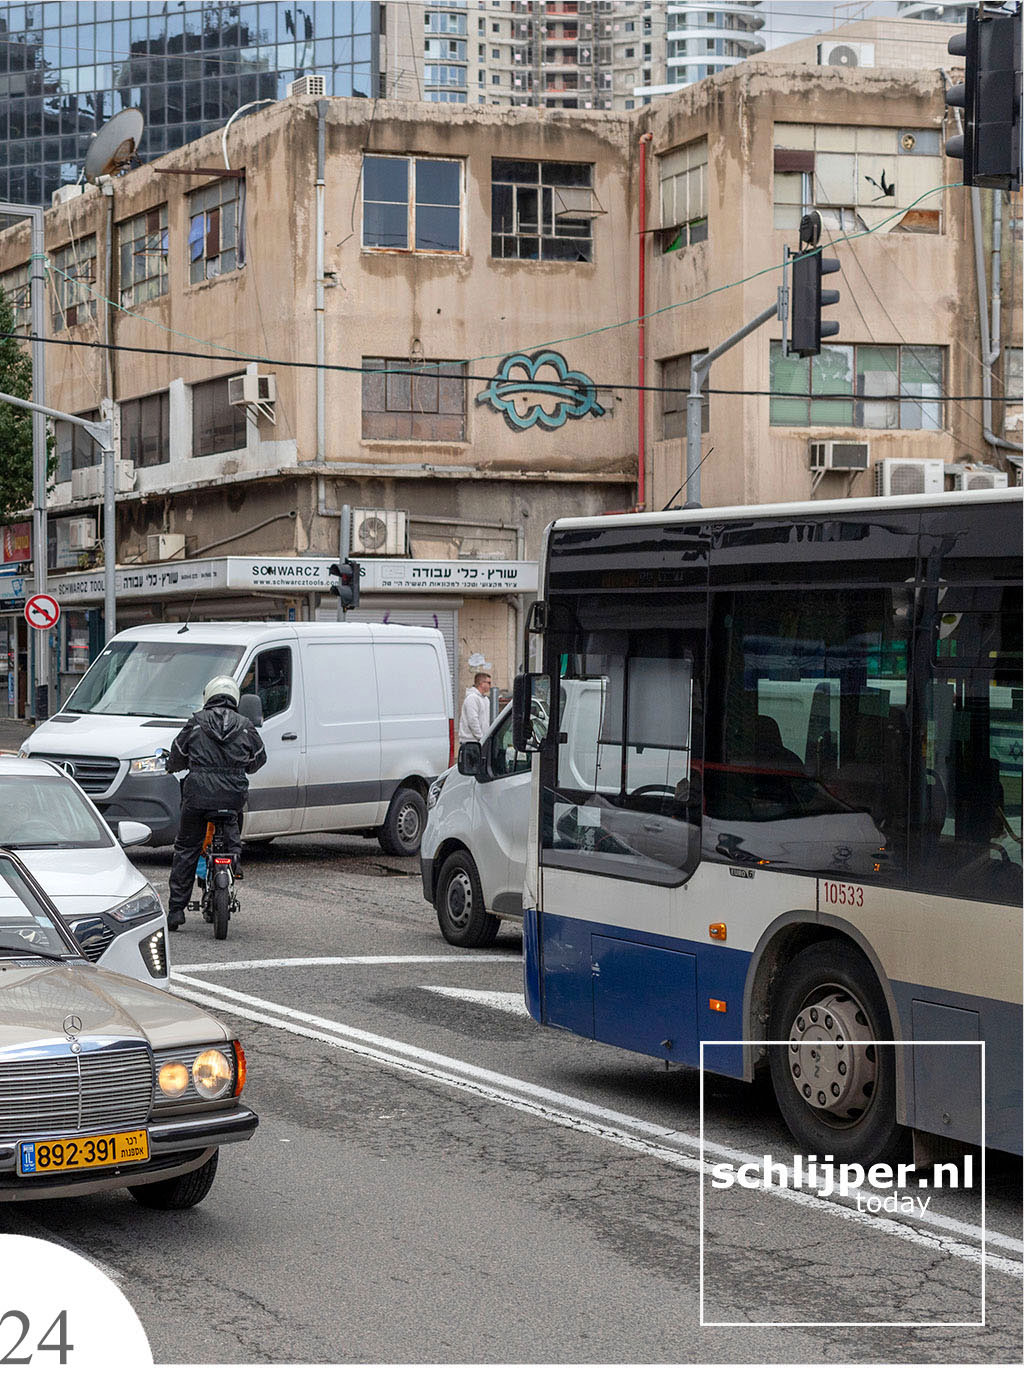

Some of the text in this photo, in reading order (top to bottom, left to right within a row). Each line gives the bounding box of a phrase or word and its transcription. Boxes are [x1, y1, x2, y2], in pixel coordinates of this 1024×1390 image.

[252, 565, 320, 577] SCHWARCZ
[412, 567, 518, 580] שורץ כלי עבודה
[58, 580, 105, 595] SCHWARCZ TOOL
[824, 881, 864, 907] 10533
[121, 1147, 144, 1158] אספנות
